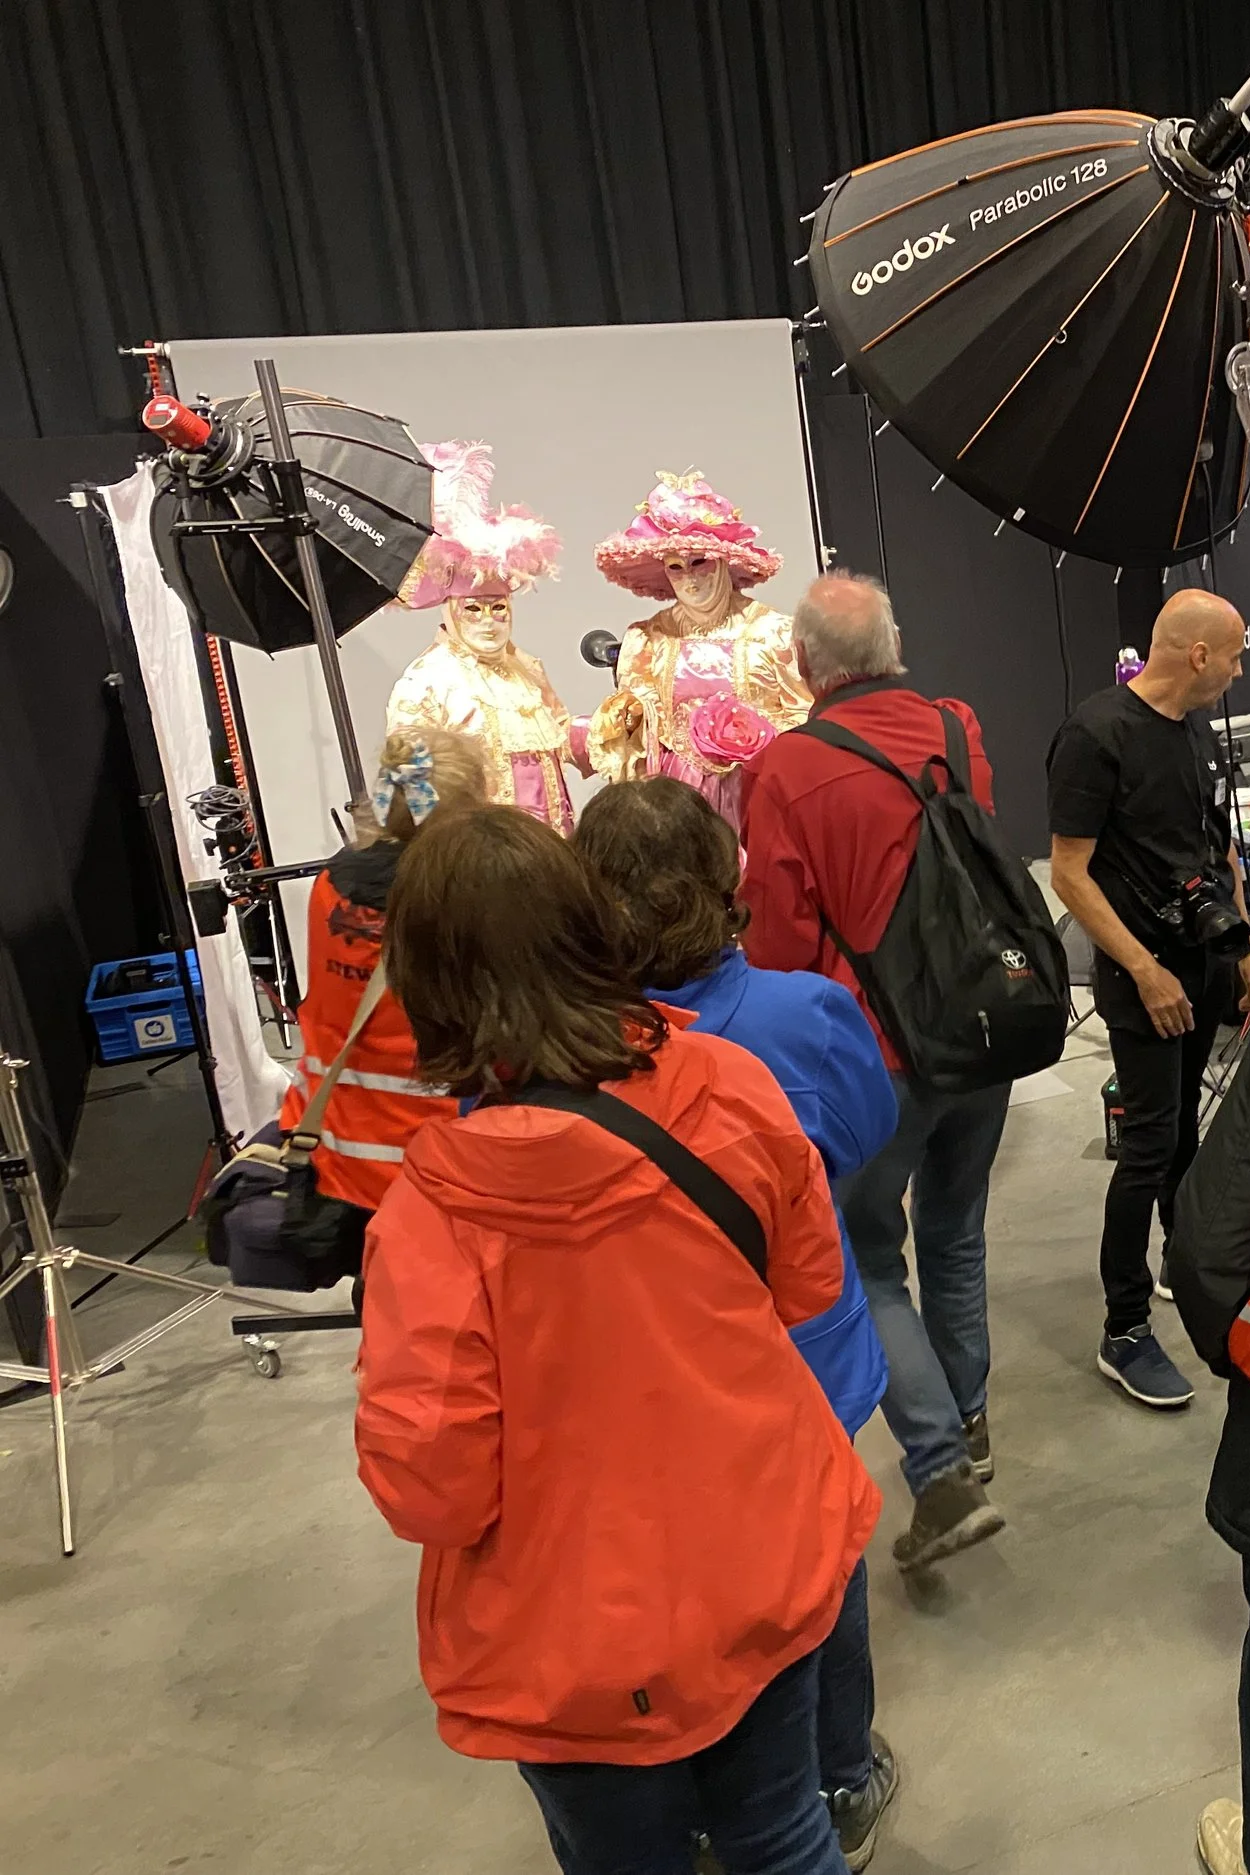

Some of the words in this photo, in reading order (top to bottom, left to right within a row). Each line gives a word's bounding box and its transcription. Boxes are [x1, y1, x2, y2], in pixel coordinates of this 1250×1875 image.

[851, 223, 956, 296] Godox
[969, 175, 1067, 231] Parabolic
[1070, 158, 1108, 187] 128
[338, 504, 386, 547] SmallRig
[326, 959, 371, 982] STEW
